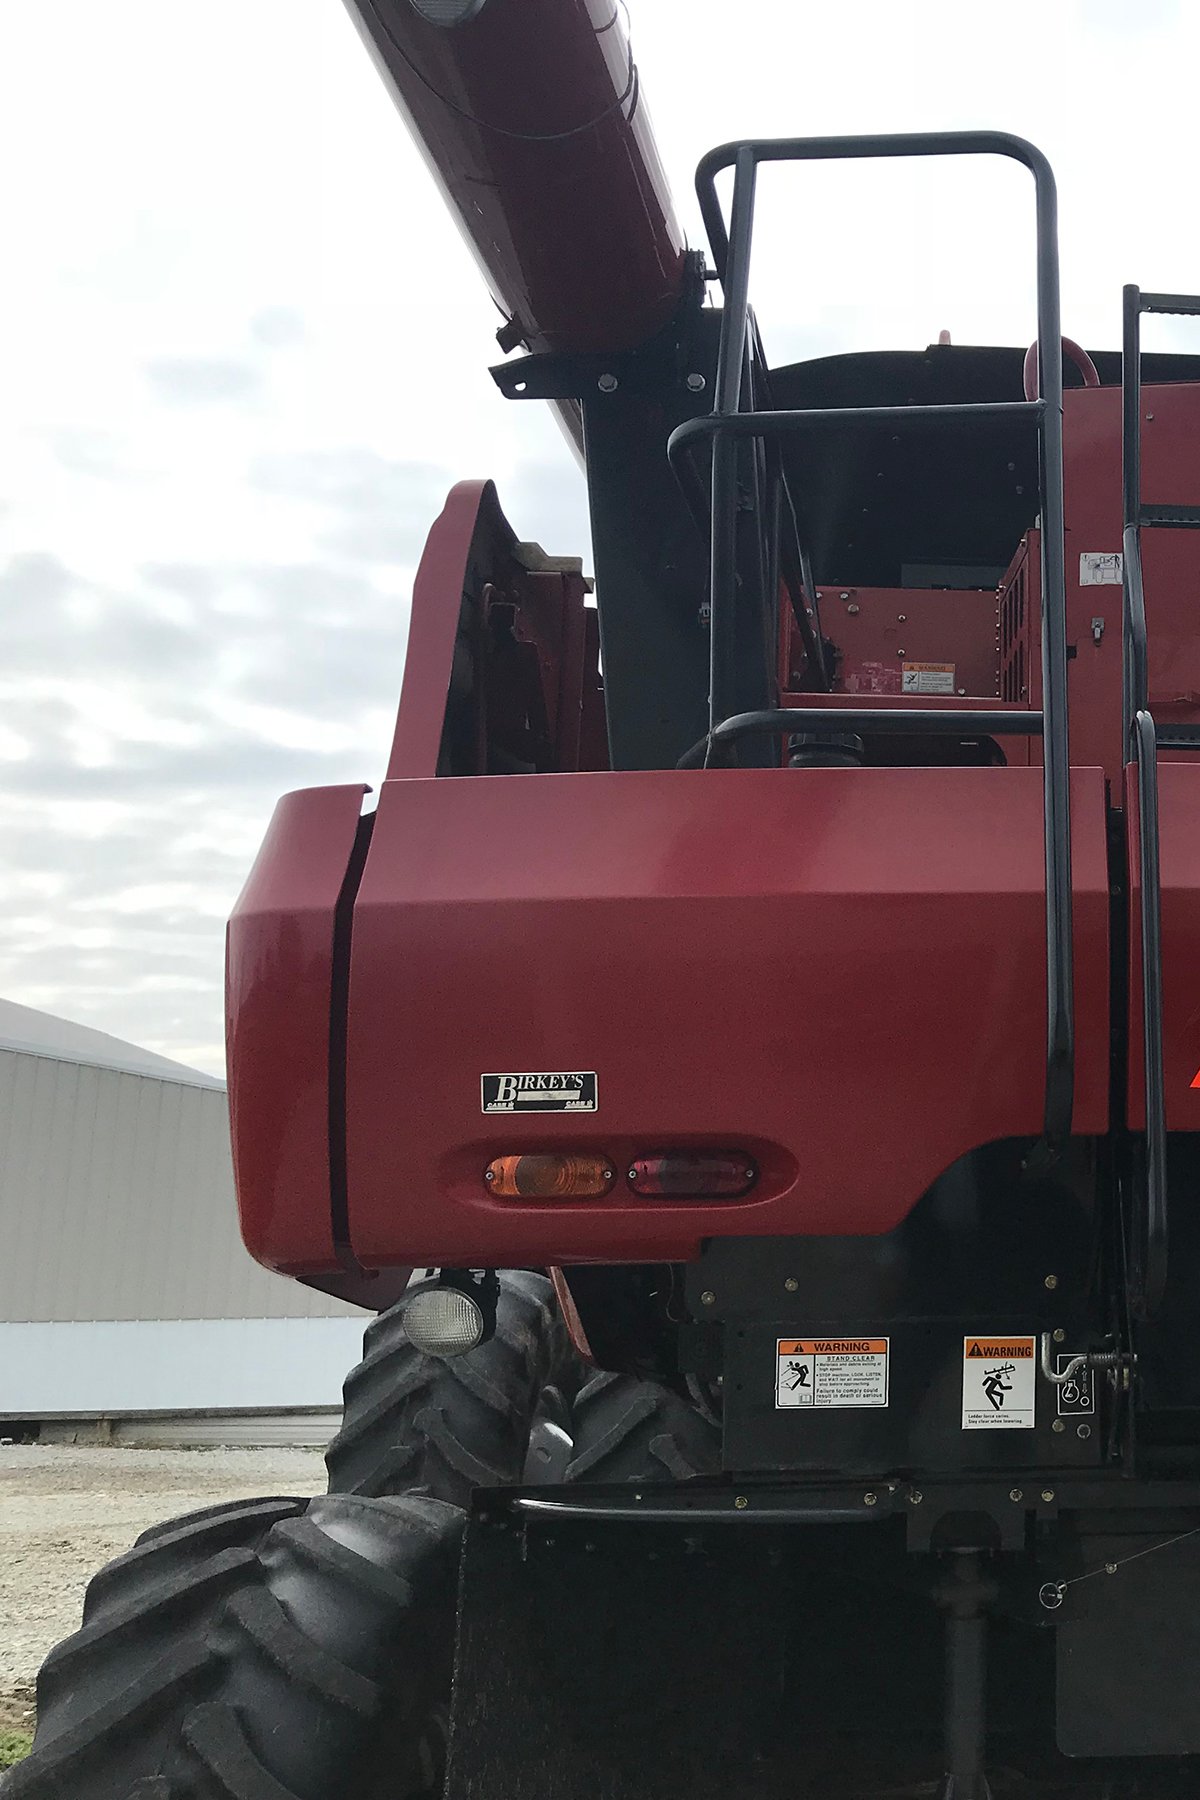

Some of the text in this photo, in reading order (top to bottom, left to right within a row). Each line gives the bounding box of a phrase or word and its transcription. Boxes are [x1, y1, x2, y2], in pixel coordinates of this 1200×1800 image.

[494, 1074, 584, 1102] BIRKEY'S
[814, 1342, 870, 1352] WARNING
[983, 1346, 1032, 1356] WARNING
